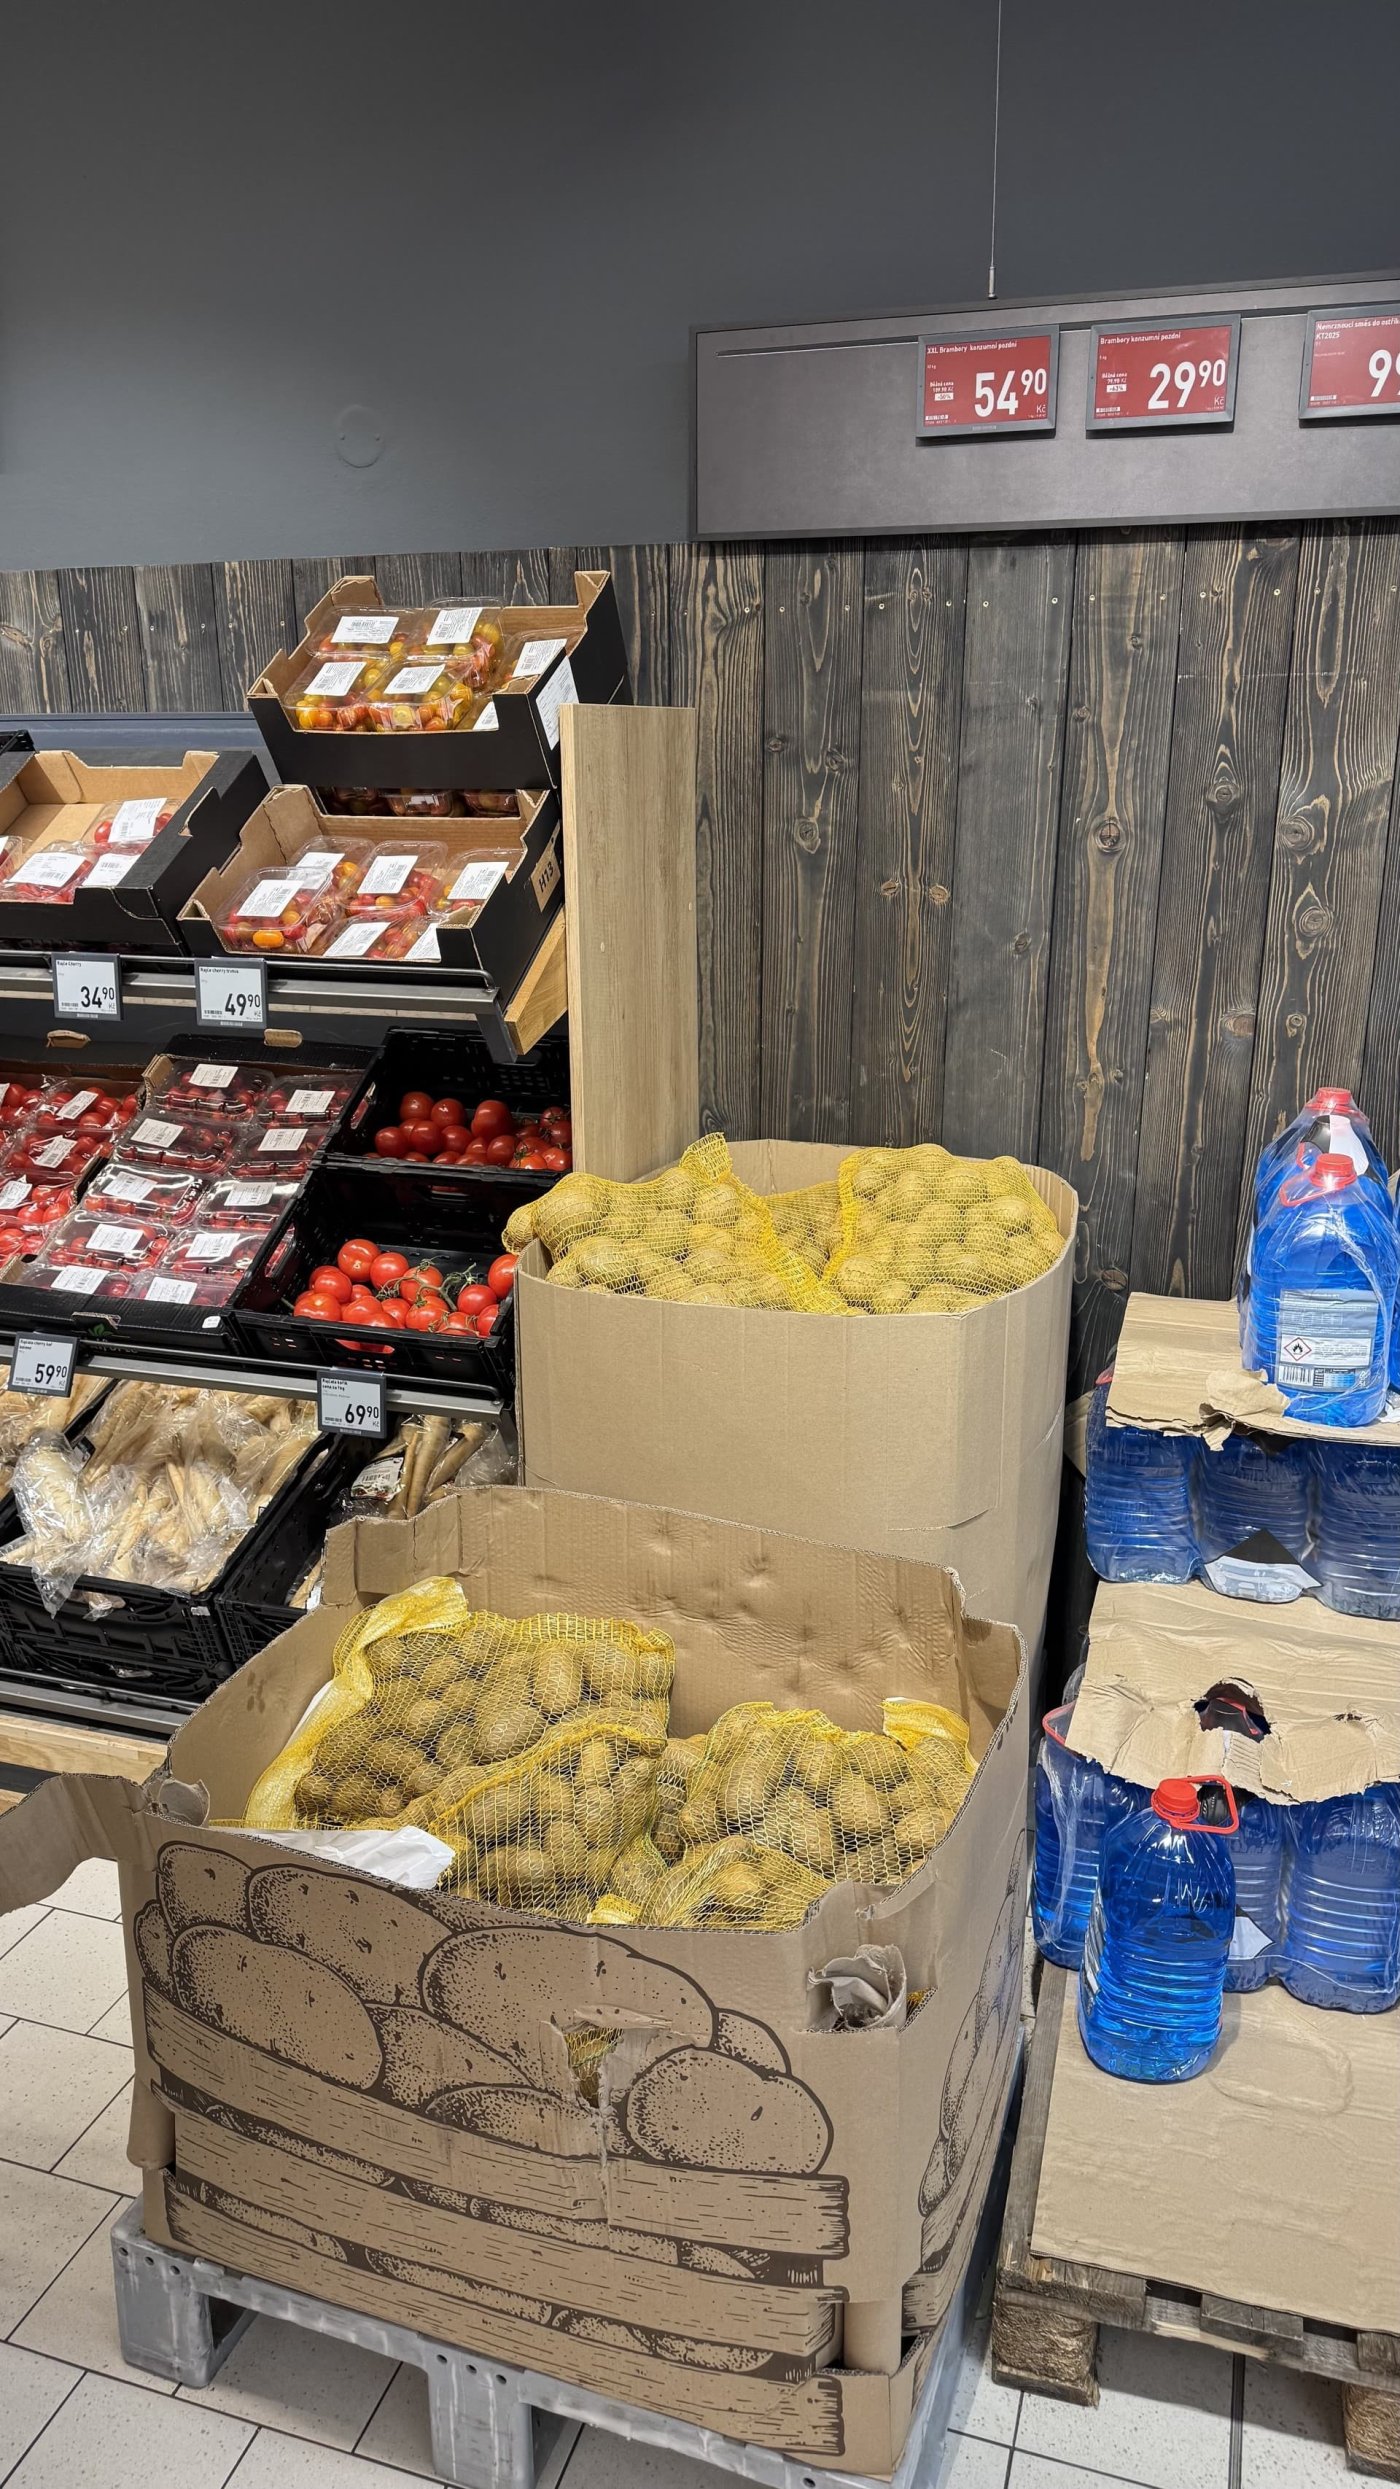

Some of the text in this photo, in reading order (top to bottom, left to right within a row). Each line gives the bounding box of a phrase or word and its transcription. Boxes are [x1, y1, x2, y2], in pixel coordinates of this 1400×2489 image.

[1100, 332, 1181, 345] Brambory konzumní pozdní
[940, 345, 968, 354] Brambory
[970, 342, 997, 351] konzumní
[998, 340, 1018, 350] pozdní
[1368, 349, 1400, 398] 9
[1214, 396, 1224, 406] Kč
[1036, 404, 1046, 414] Kč
